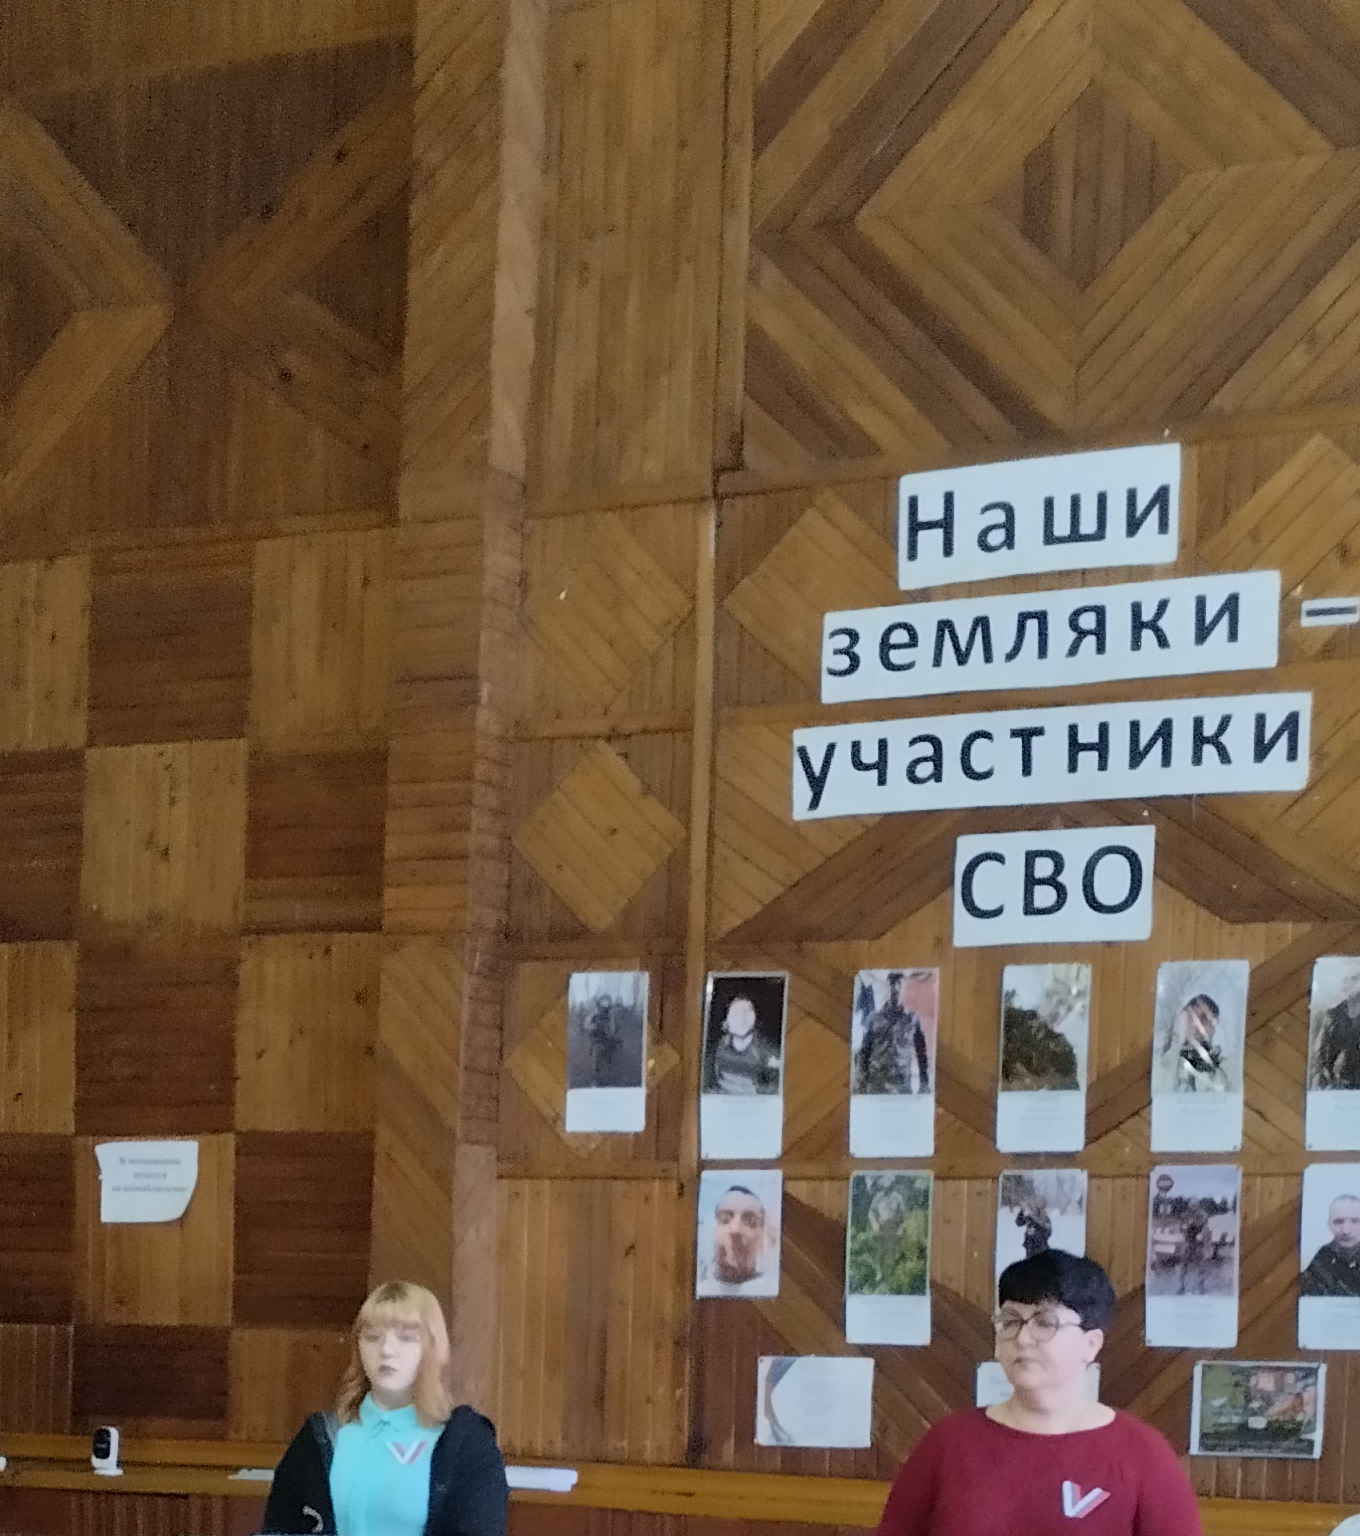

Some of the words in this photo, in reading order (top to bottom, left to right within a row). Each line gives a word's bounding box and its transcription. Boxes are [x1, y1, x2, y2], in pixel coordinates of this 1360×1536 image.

[905, 483, 1172, 562] Наши
[825, 591, 1242, 678] земляки
[796, 709, 1301, 812] участники
[959, 844, 1143, 920] СВО
